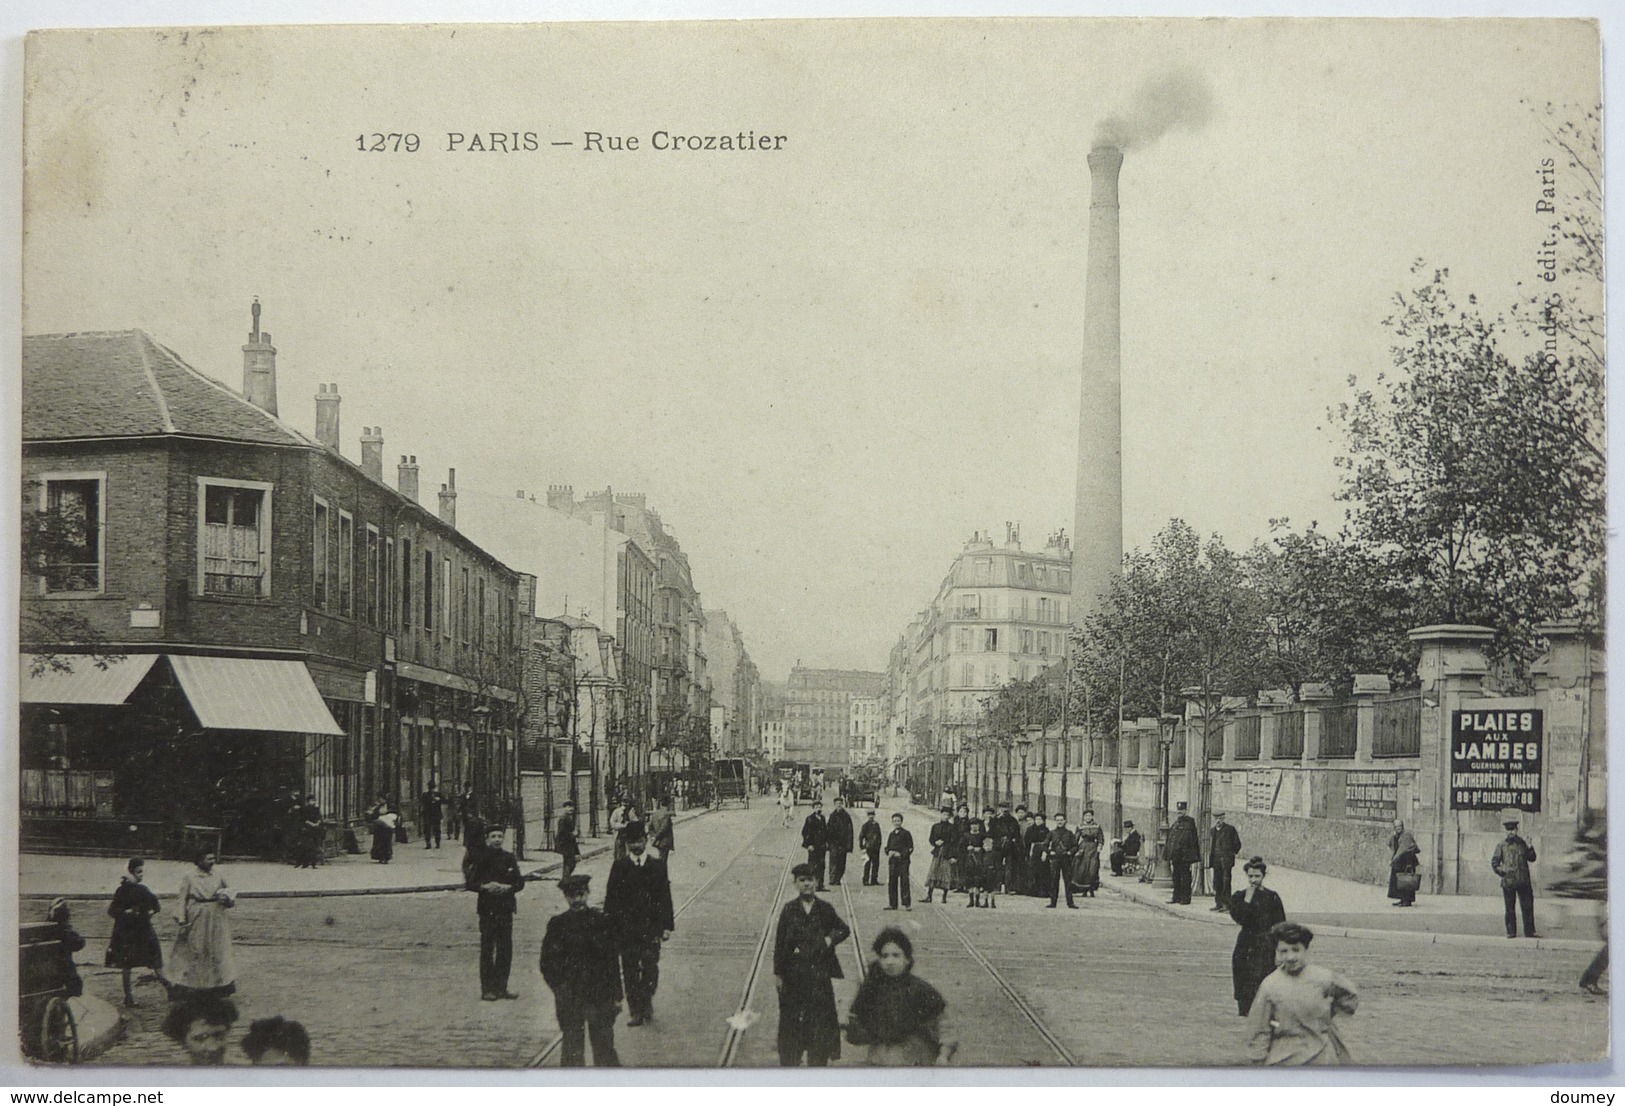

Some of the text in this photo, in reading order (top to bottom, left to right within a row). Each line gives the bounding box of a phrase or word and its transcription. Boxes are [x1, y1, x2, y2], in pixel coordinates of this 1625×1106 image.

[1460, 713, 1532, 731] PLAIES
[1485, 733, 1508, 741] AUX
[1454, 742, 1537, 760] JAMBES
[1509, 762, 1523, 770] PAR
[1482, 791, 1517, 804] DIDEROT
